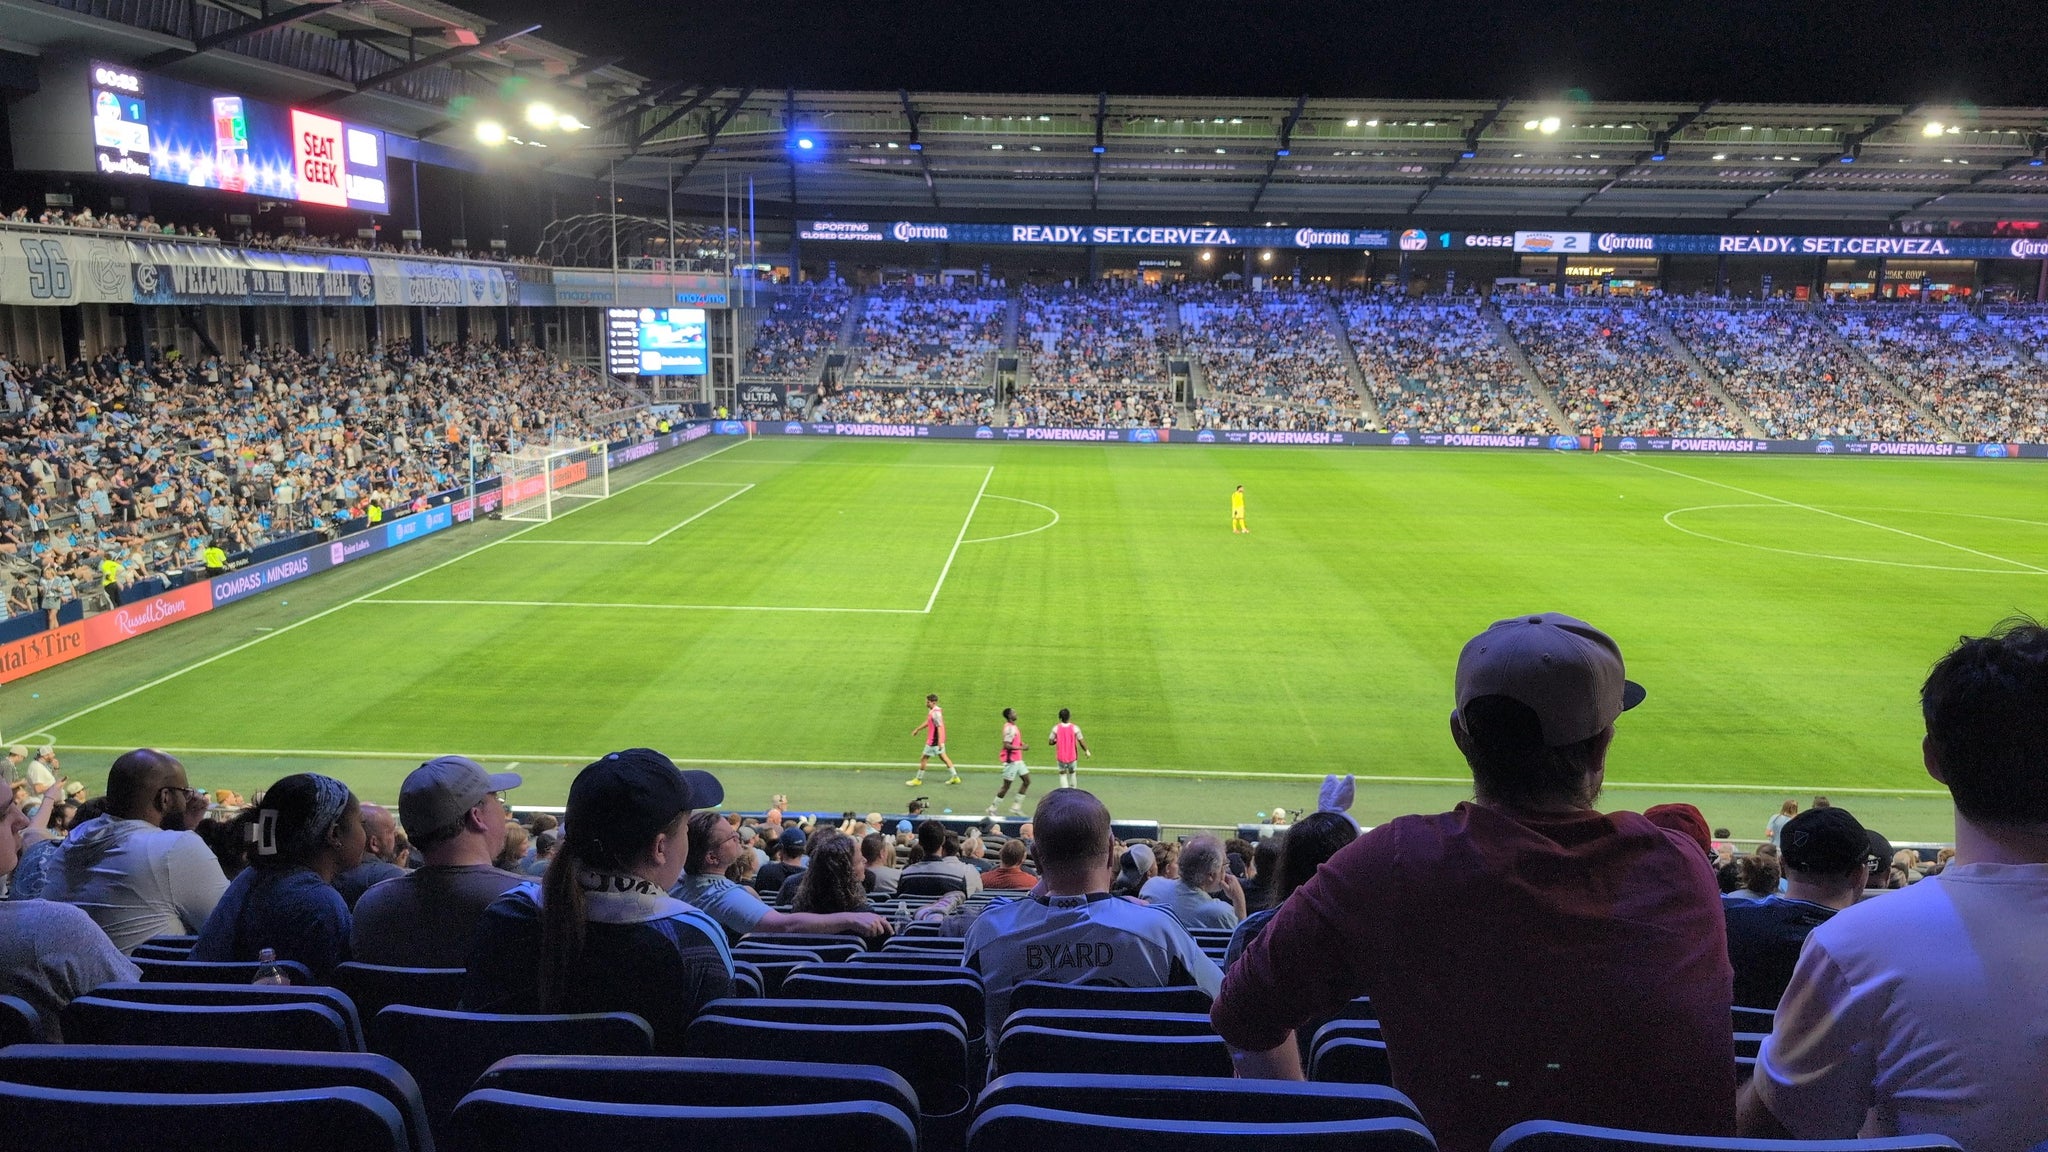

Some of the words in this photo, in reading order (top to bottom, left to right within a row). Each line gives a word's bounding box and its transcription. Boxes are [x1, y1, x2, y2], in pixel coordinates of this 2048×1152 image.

[129, 104, 140, 120] 1
[303, 131, 335, 160] SEAT
[304, 159, 339, 188] GEEK
[813, 221, 869, 232] SPORTING
[893, 221, 949, 243] Corona
[1012, 225, 1087, 243] READY.
[801, 231, 837, 240] CLOSED
[838, 232, 883, 241] CAPTIONS
[1295, 227, 1350, 249] Corona
[1439, 232, 1451, 248] 1
[1465, 234, 1513, 248] 60:52
[1563, 236, 1577, 249] 2
[1597, 232, 1653, 253] Corona
[1719, 236, 1795, 253] READY.
[20, 238, 72, 299] 96
[170, 265, 248, 296] WELCOME
[252, 271, 264, 292] TO
[266, 271, 286, 292] THE
[290, 271, 320, 297] BLUE
[324, 272, 352, 297] HELL
[559, 290, 613, 302] mazuma
[676, 292, 727, 304] mazuma
[742, 392, 778, 402] ULTRA
[836, 423, 915, 437] POWERWASH
[1026, 427, 1105, 441] POWERWASH
[1249, 431, 1330, 444] POWERWASH
[1444, 434, 1525, 447] POWERWASH
[1672, 438, 1754, 452] POWERWASH
[1869, 442, 1951, 456] POWERWASH
[215, 572, 261, 601] COMPASS
[266, 559, 308, 583] MINERALS
[115, 602, 155, 635] Russell
[155, 597, 186, 623] Stover
[41, 631, 81, 657] Tire
[1026, 942, 1113, 969] BYARD
